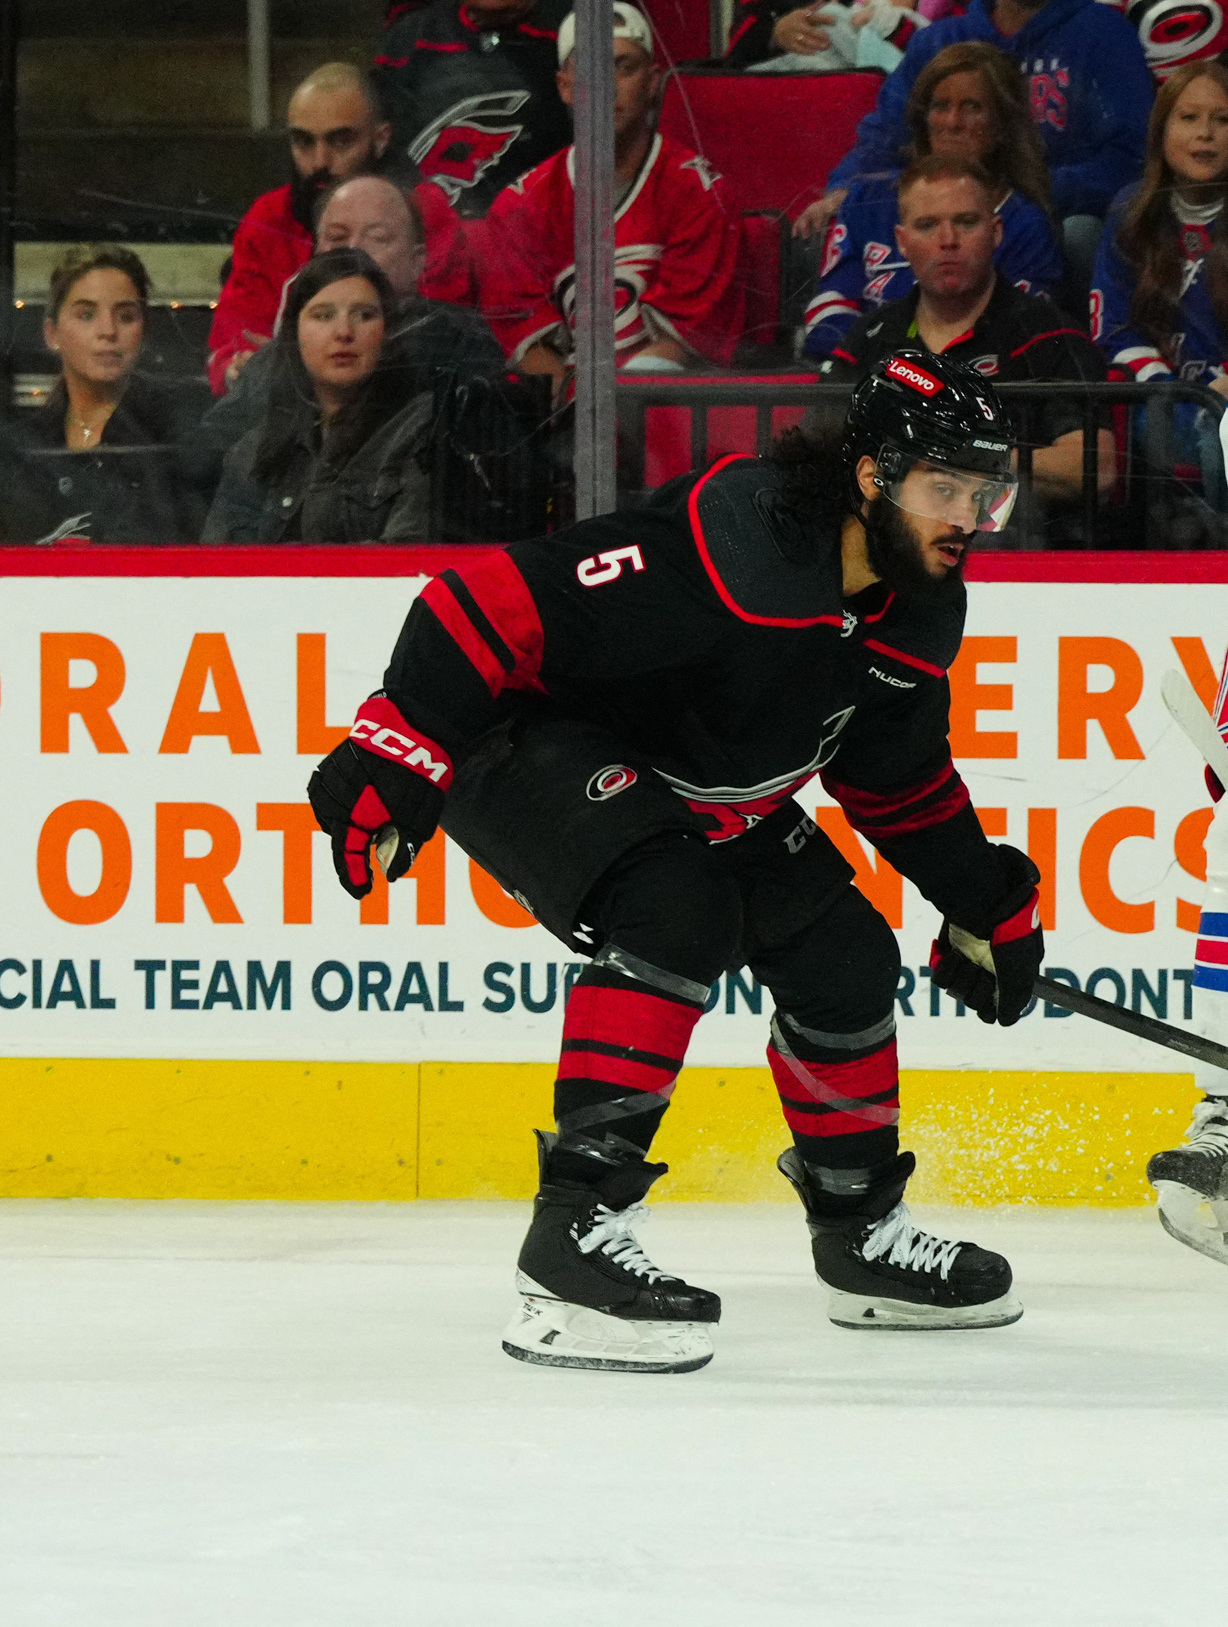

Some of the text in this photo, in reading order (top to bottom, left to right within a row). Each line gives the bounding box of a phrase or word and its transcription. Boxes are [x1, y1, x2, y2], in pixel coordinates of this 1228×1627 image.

[889, 360, 935, 391] Lenovo
[975, 396, 994, 421] 5
[576, 544, 647, 588] 5
[0, 631, 351, 756] RAL
[348, 717, 448, 783] CCM
[782, 813, 818, 854] CC
[134, 959, 292, 1012] TEAM
[311, 961, 465, 1013] ORAL
